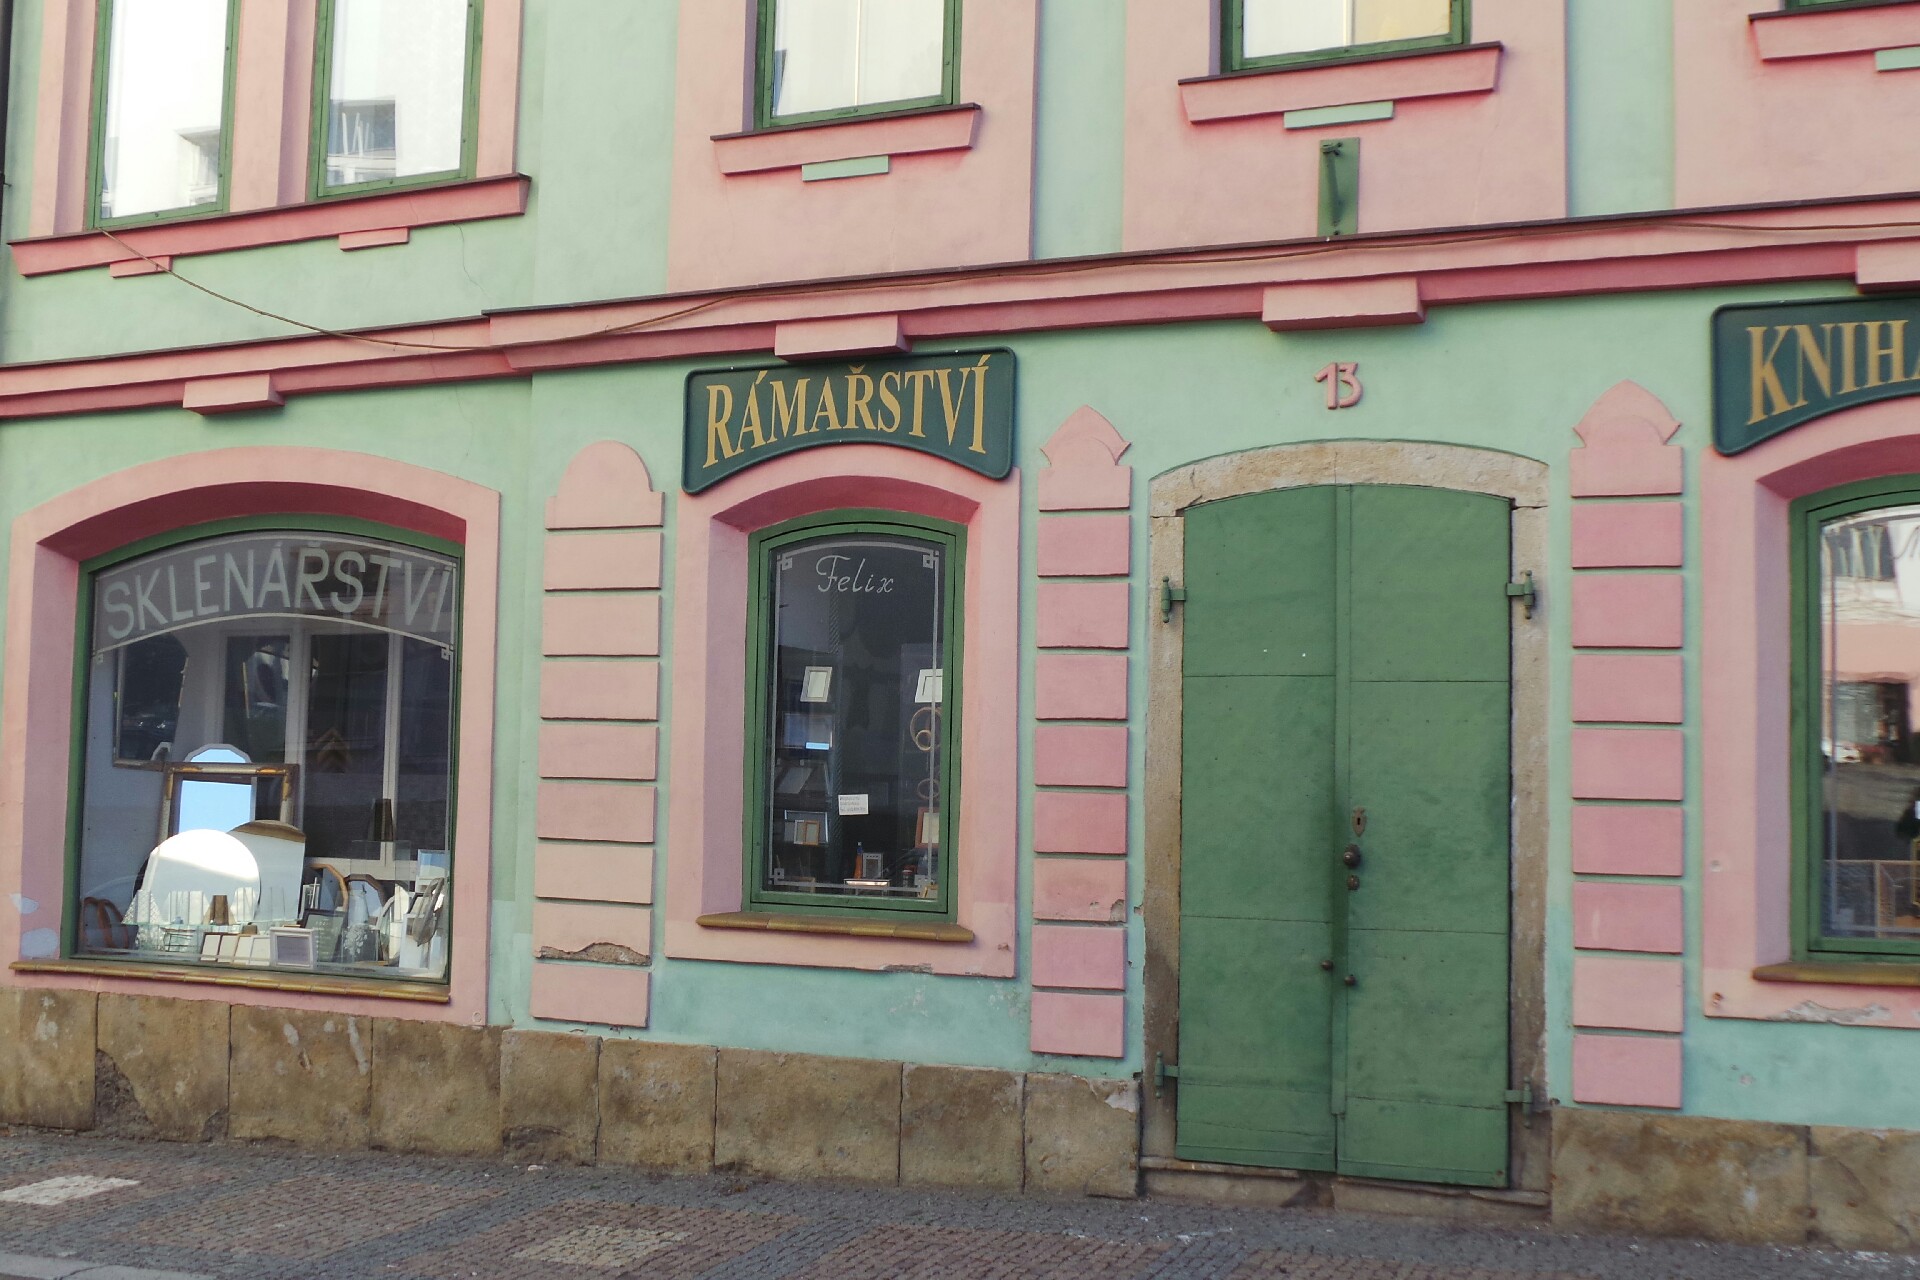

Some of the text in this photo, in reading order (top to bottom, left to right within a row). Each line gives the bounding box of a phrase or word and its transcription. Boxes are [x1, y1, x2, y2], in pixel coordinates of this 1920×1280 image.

[702, 354, 991, 469] RÁMAŘSTVÍ
[1313, 361, 1363, 410] 13
[1745, 319, 1920, 425] KNIH
[103, 541, 453, 641] SKLENÁŘSTVÍ
[815, 554, 894, 594] Felix
